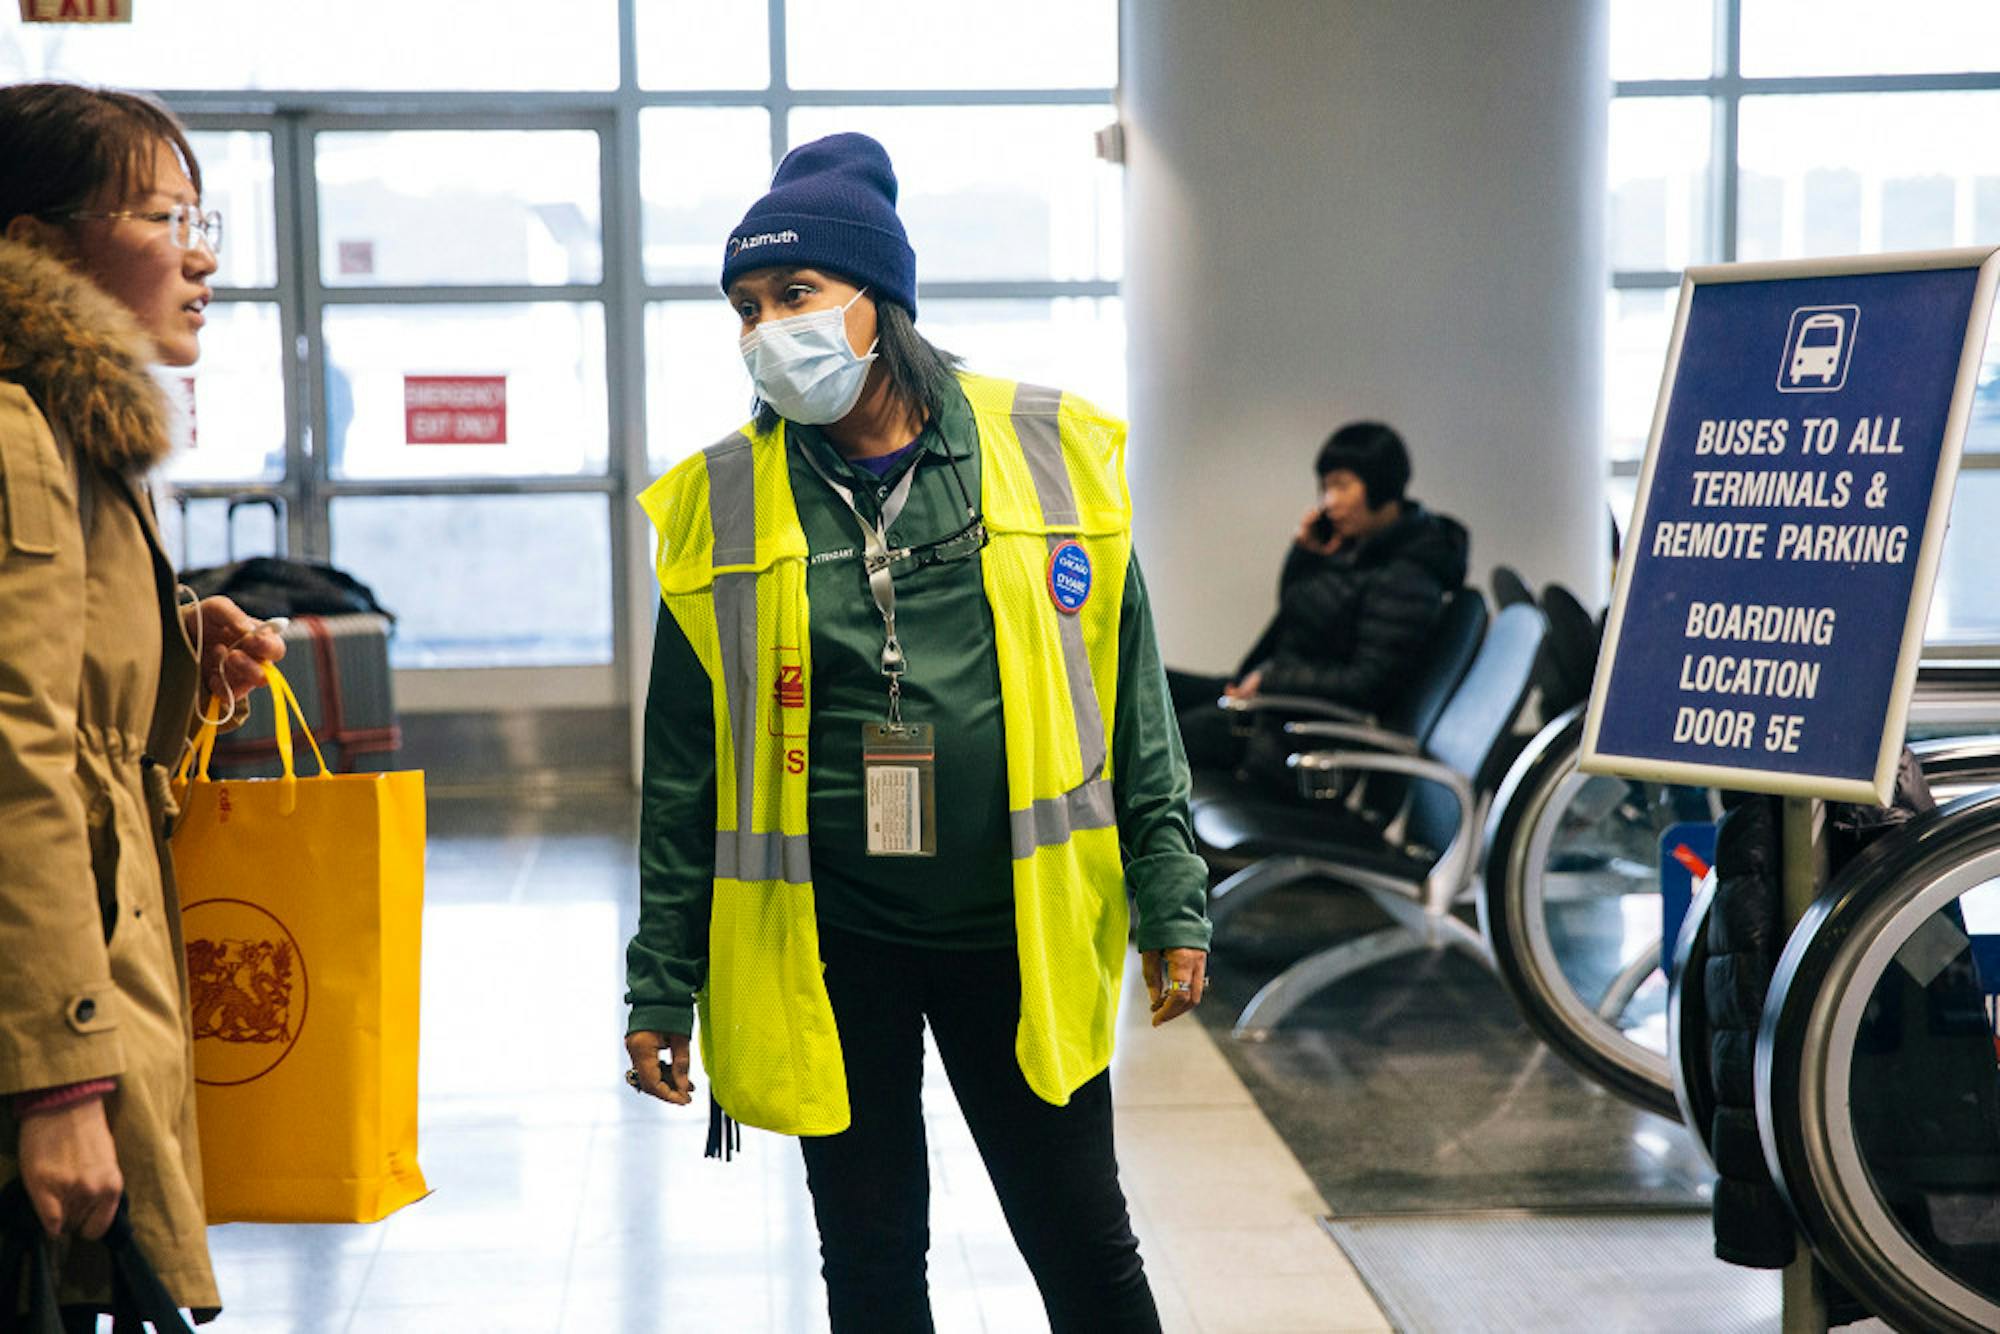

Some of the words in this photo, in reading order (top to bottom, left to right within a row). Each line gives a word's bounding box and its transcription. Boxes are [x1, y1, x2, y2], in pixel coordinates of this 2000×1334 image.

[740, 229, 799, 251] Azimuth
[1695, 418, 1789, 455] BUSES
[1802, 417, 1839, 455] TO
[1847, 416, 1904, 454] ALL
[1691, 471, 1853, 509] TERMINALS
[1865, 471, 1888, 509] &
[1652, 521, 1768, 559] REMOTE
[1775, 524, 1909, 564] PARKING
[1685, 601, 1836, 646] BOARDING
[1679, 654, 1821, 700] LOCATION
[1673, 706, 1755, 749] DOOR
[1764, 714, 1804, 753] 5E
